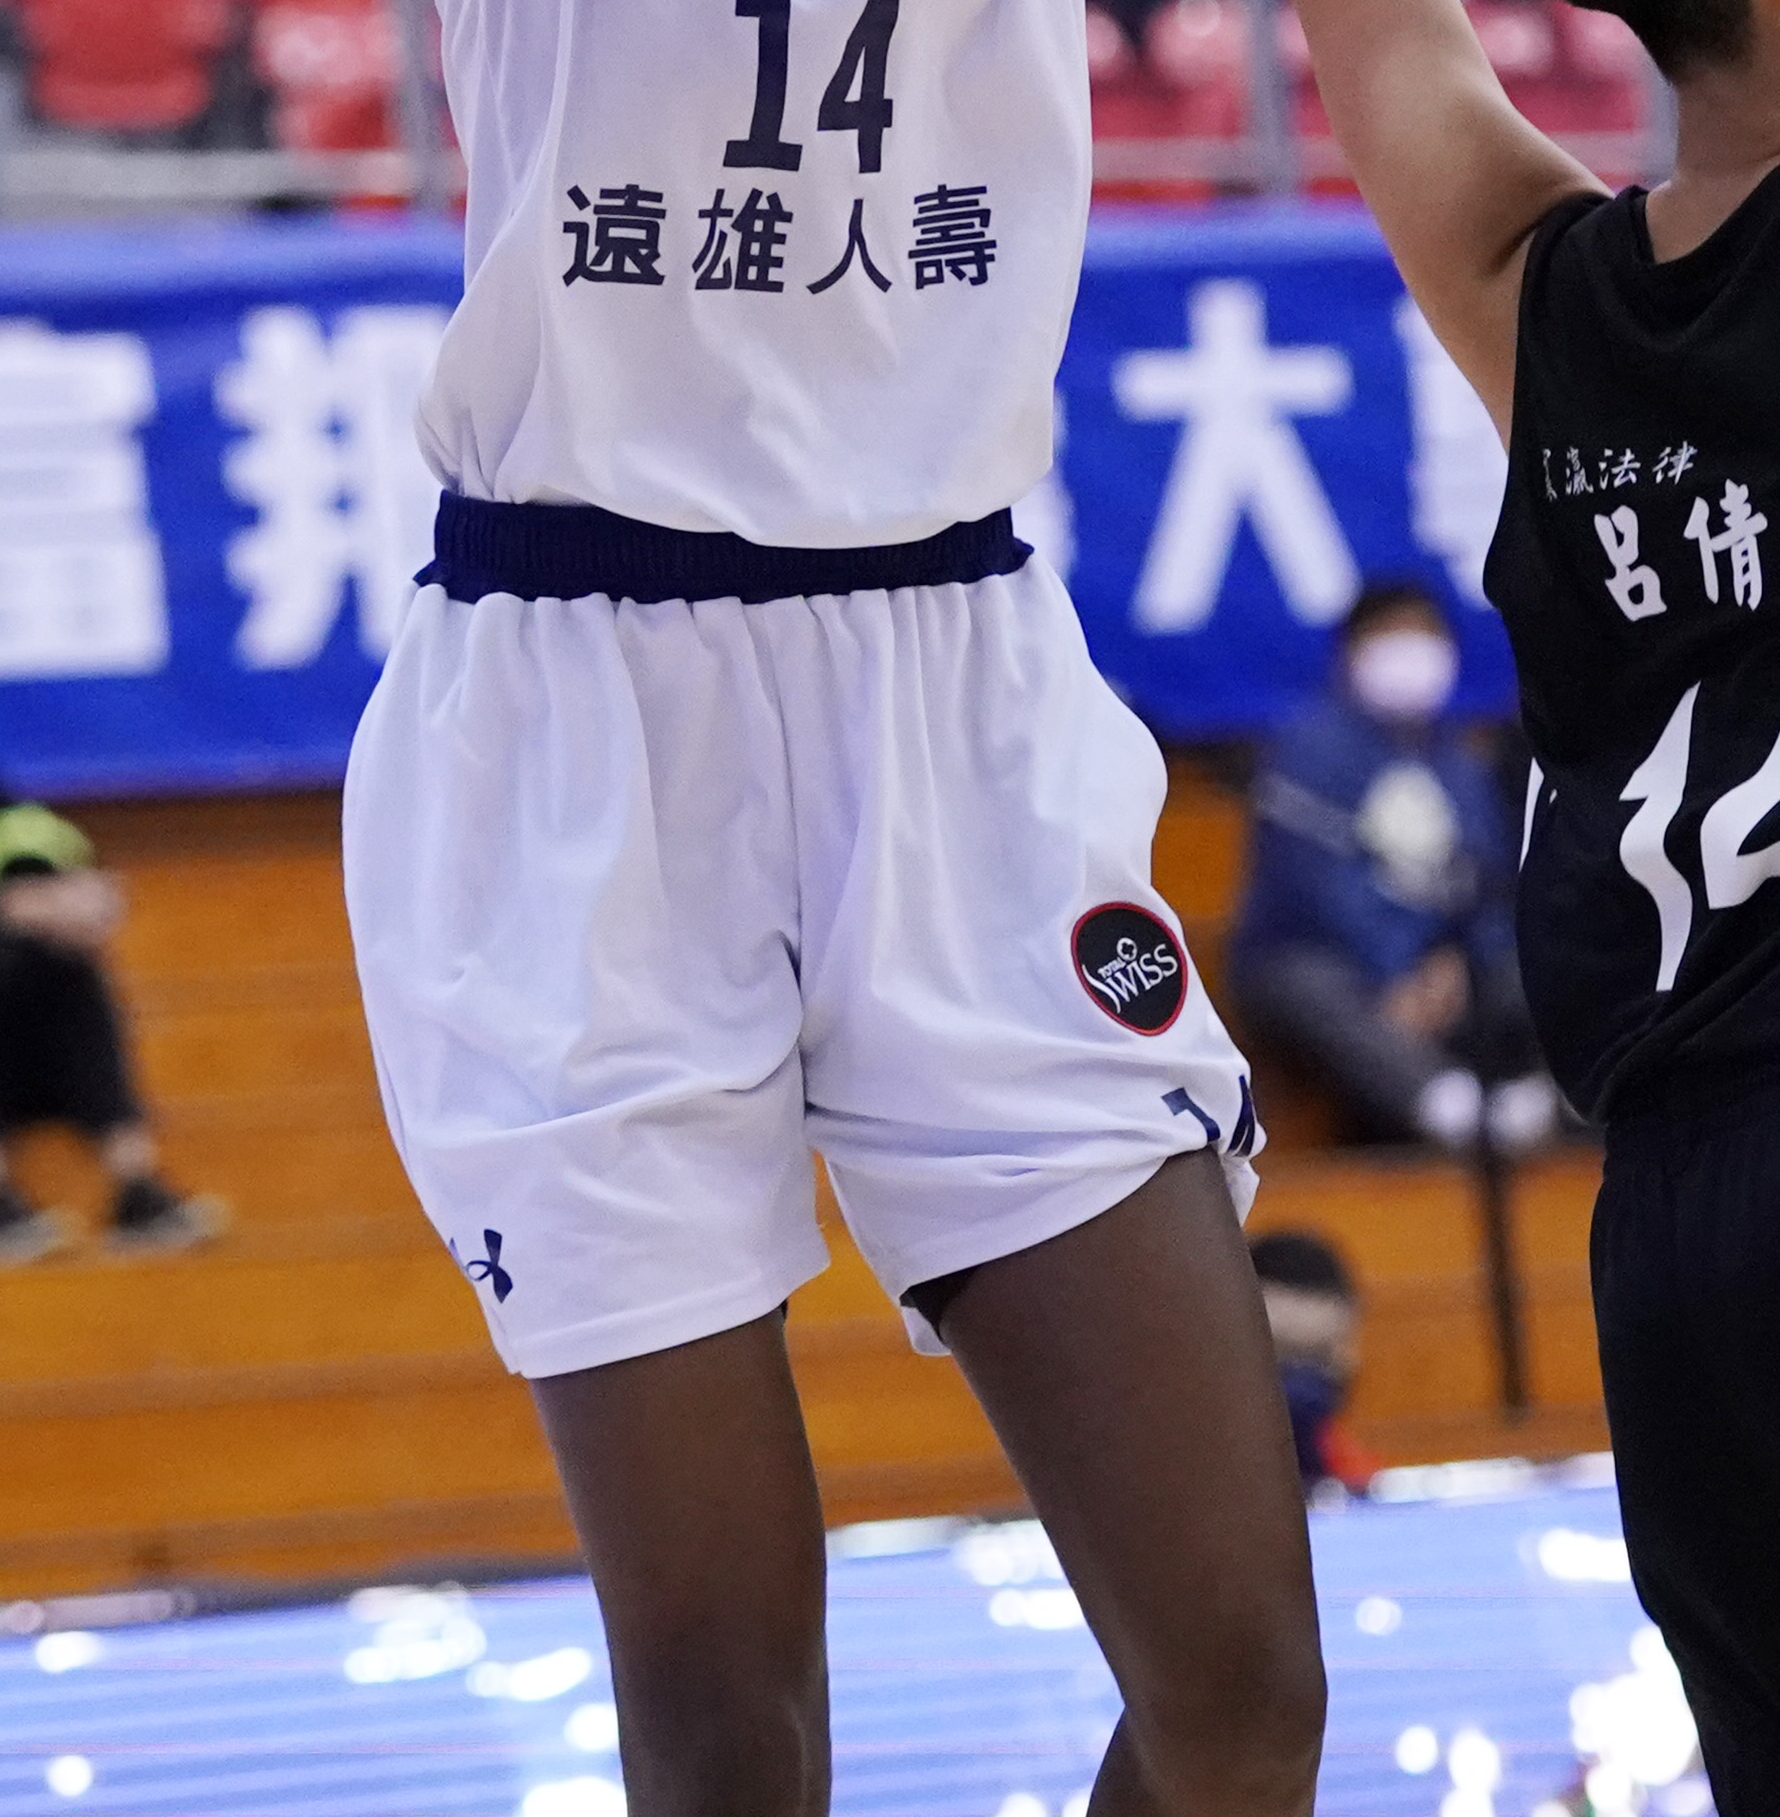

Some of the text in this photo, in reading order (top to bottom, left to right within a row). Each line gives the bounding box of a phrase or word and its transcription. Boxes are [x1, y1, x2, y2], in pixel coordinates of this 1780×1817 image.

[562, 184, 997, 294] 遠雄人壽
[1082, 943, 1179, 1014] SWISS
